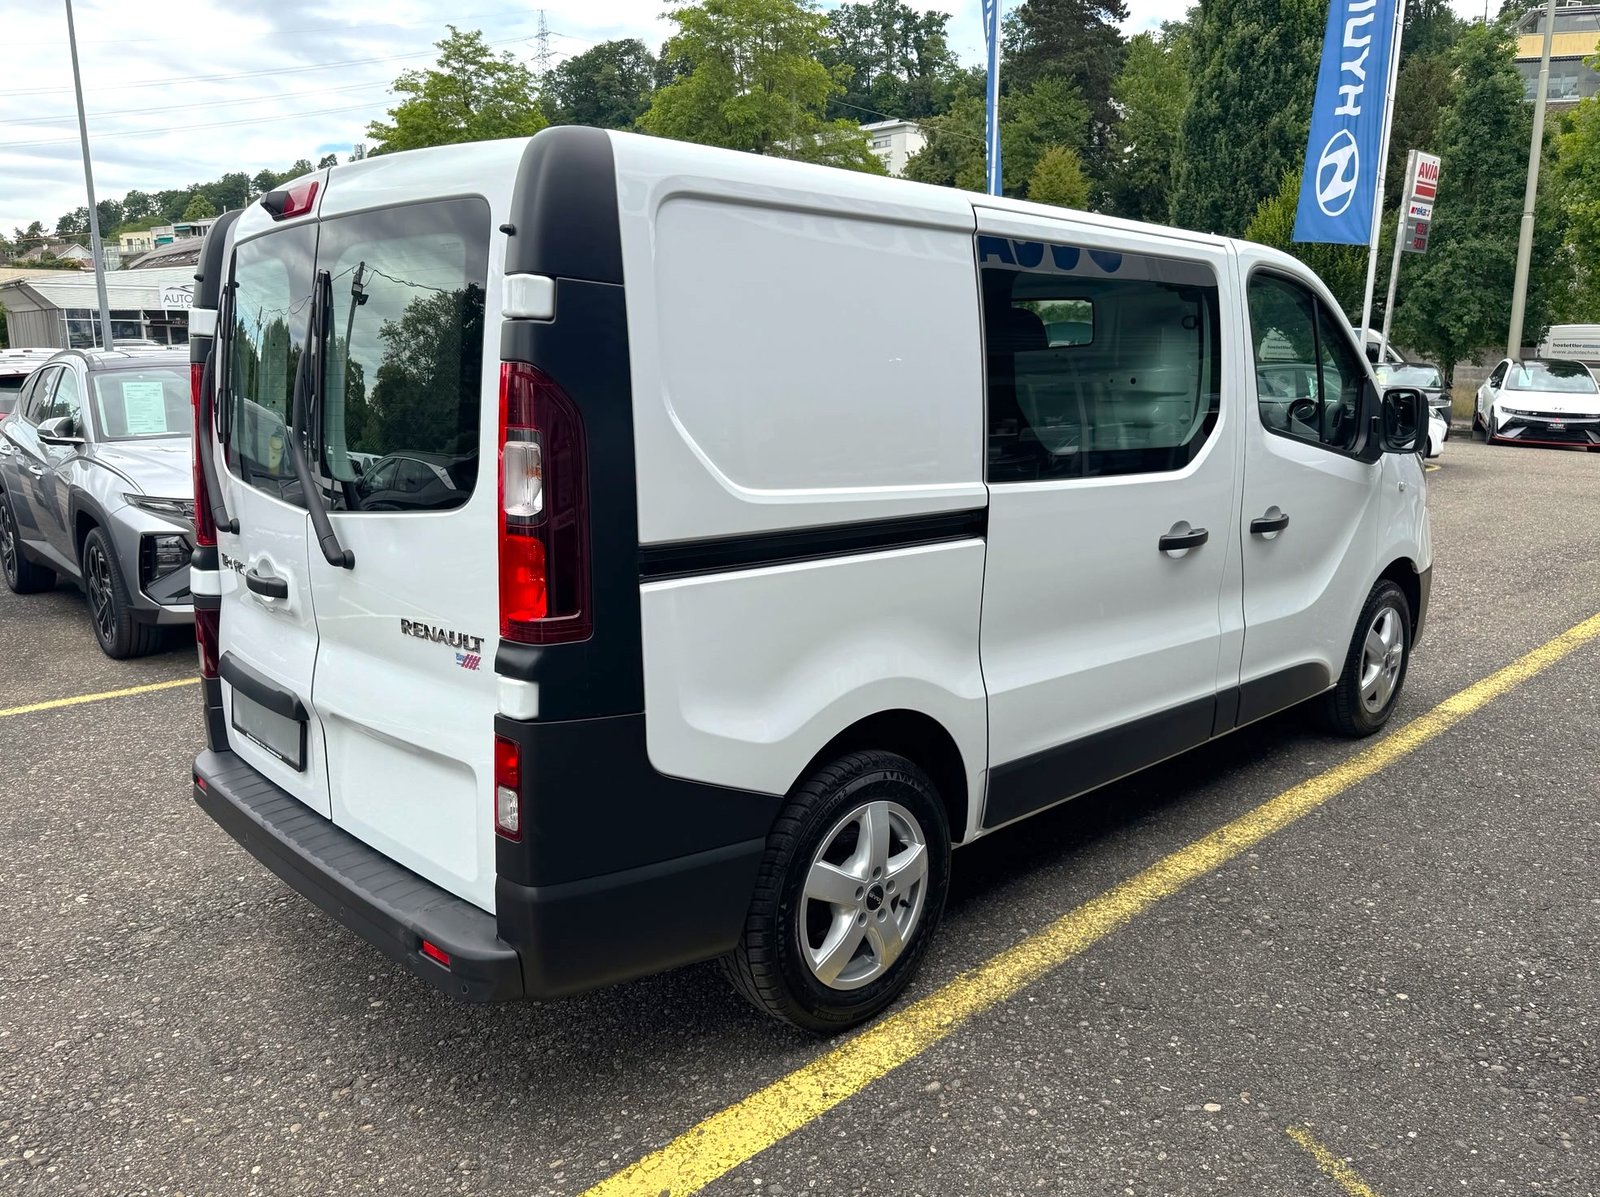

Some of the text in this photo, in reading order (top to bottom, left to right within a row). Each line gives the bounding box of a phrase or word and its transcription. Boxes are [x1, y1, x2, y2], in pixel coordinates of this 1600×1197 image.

[1418, 161, 1438, 181] AVIA
[163, 294, 194, 303] AUTO
[401, 618, 485, 653] RENAULT
